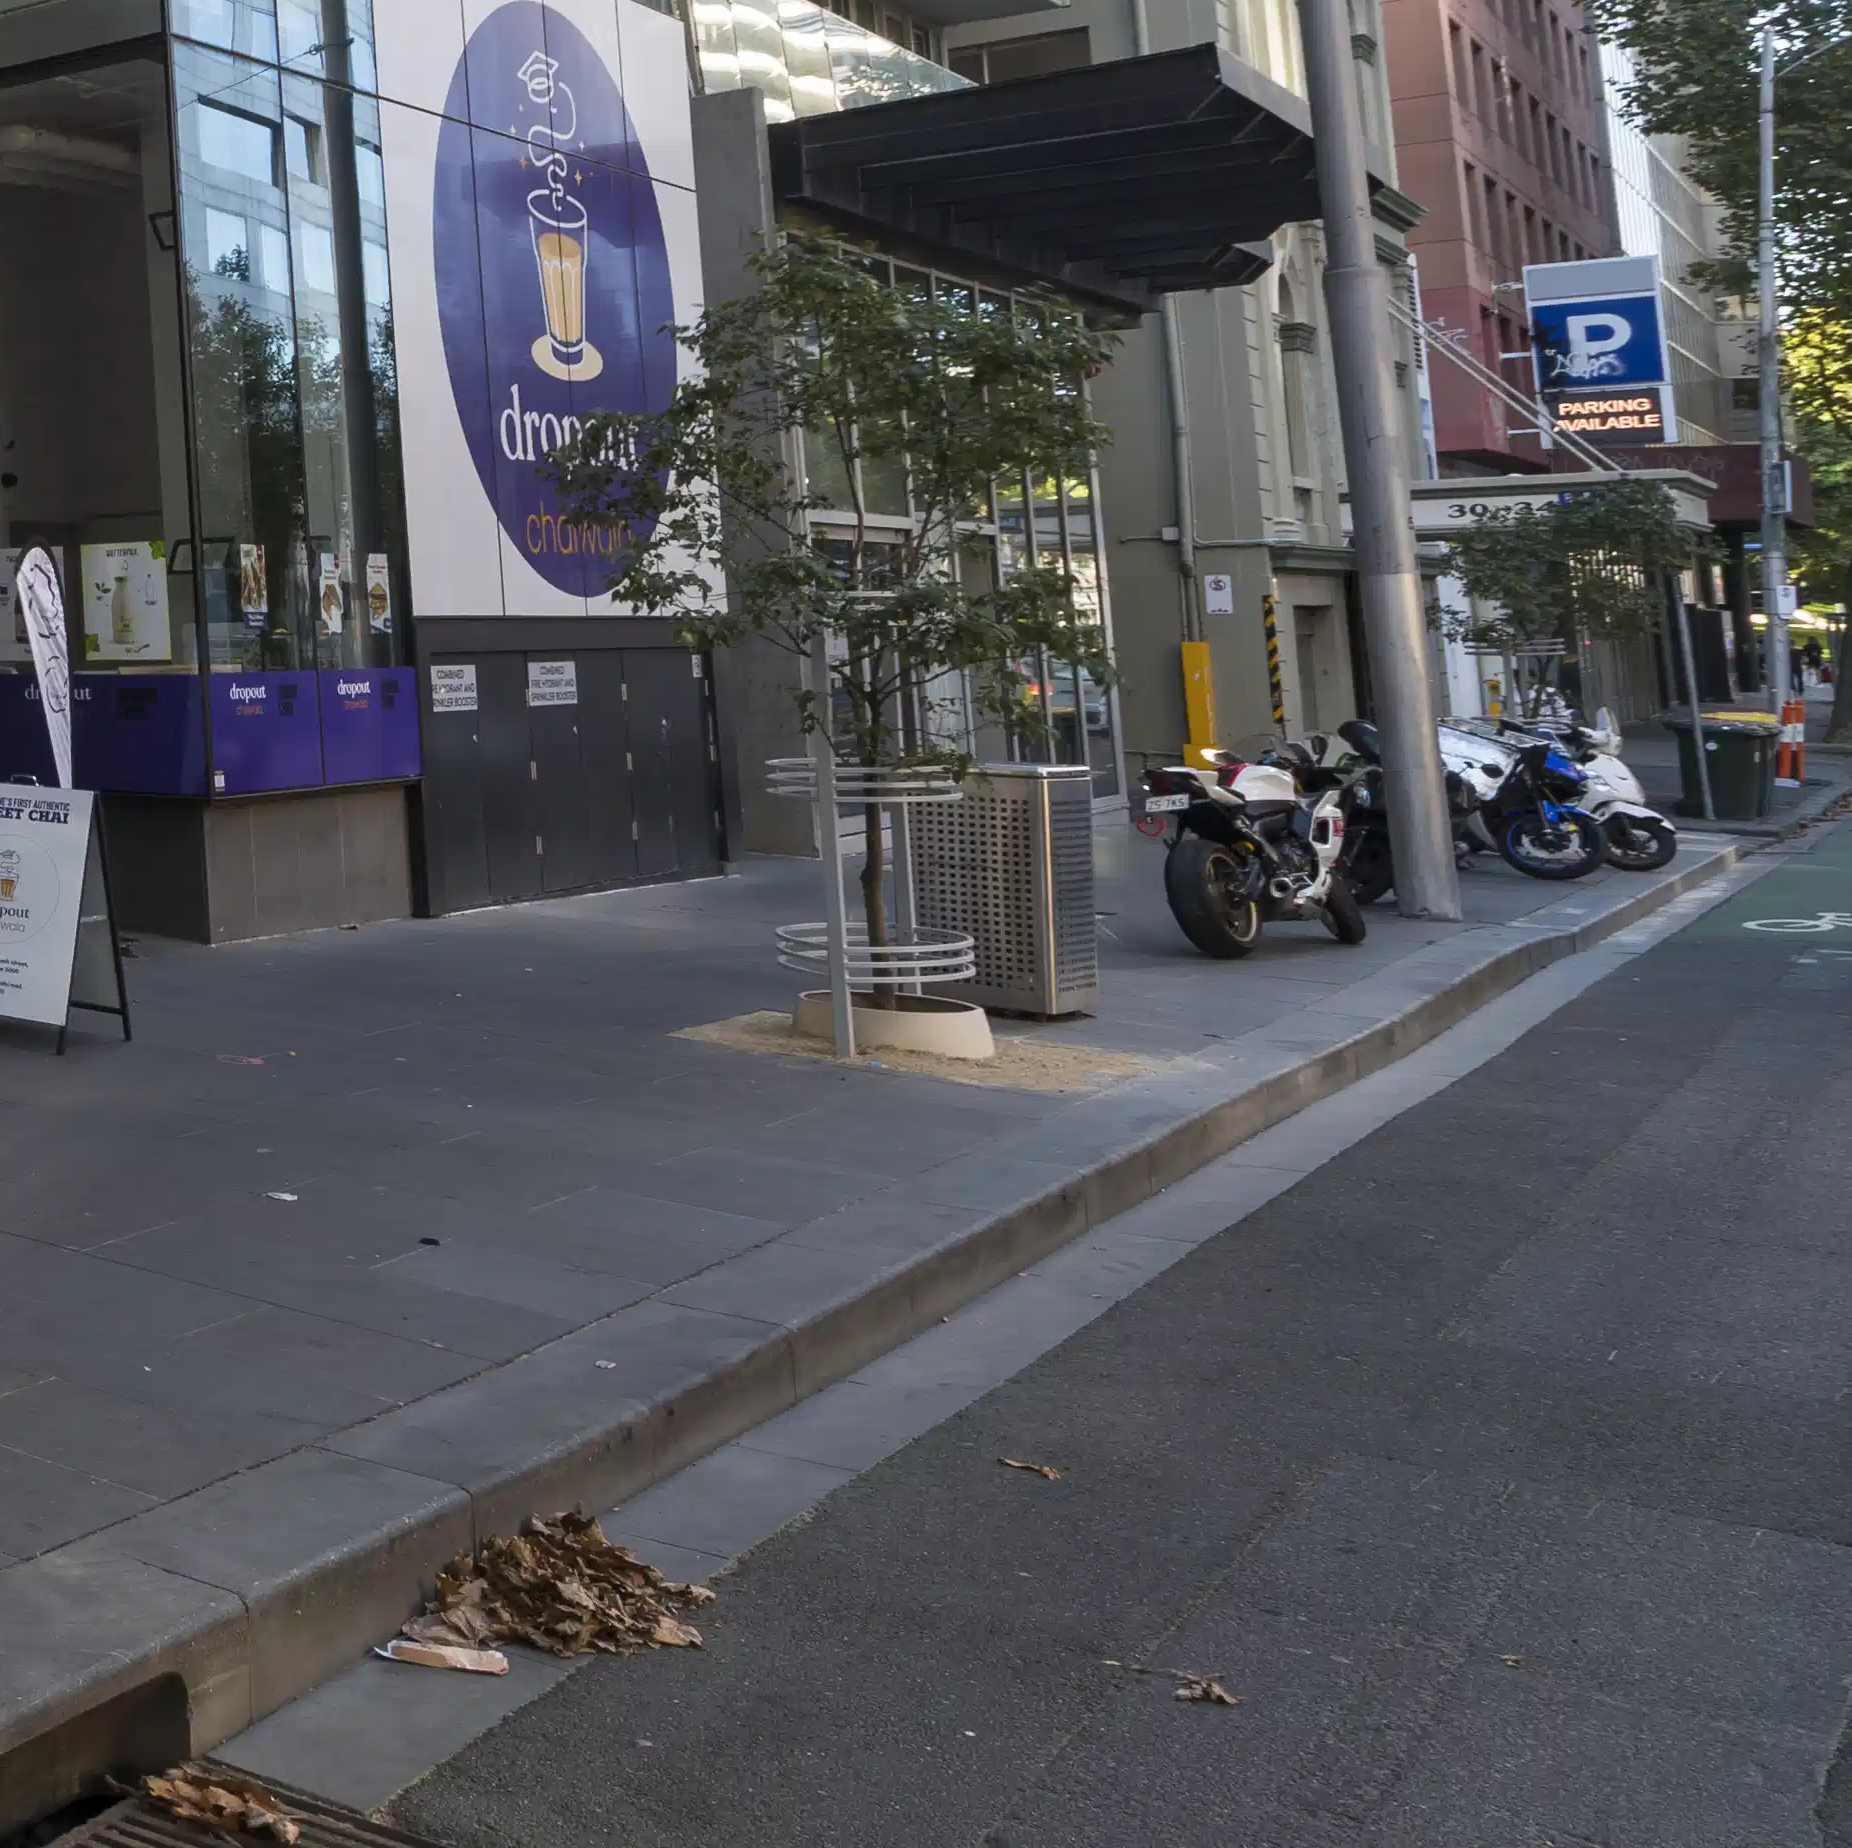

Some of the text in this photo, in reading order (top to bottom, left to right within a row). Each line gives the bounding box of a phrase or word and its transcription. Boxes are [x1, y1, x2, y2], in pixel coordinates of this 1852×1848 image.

[1566, 313, 1632, 373] P
[1558, 398, 1652, 416] PARKING
[1554, 414, 1661, 433] AVAILABLE
[229, 682, 267, 704] dropout
[337, 678, 371, 699] dropout
[13, 798, 32, 809] FIRST
[33, 800, 70, 812] AUTHENTIC
[28, 809, 70, 824] CHAI
